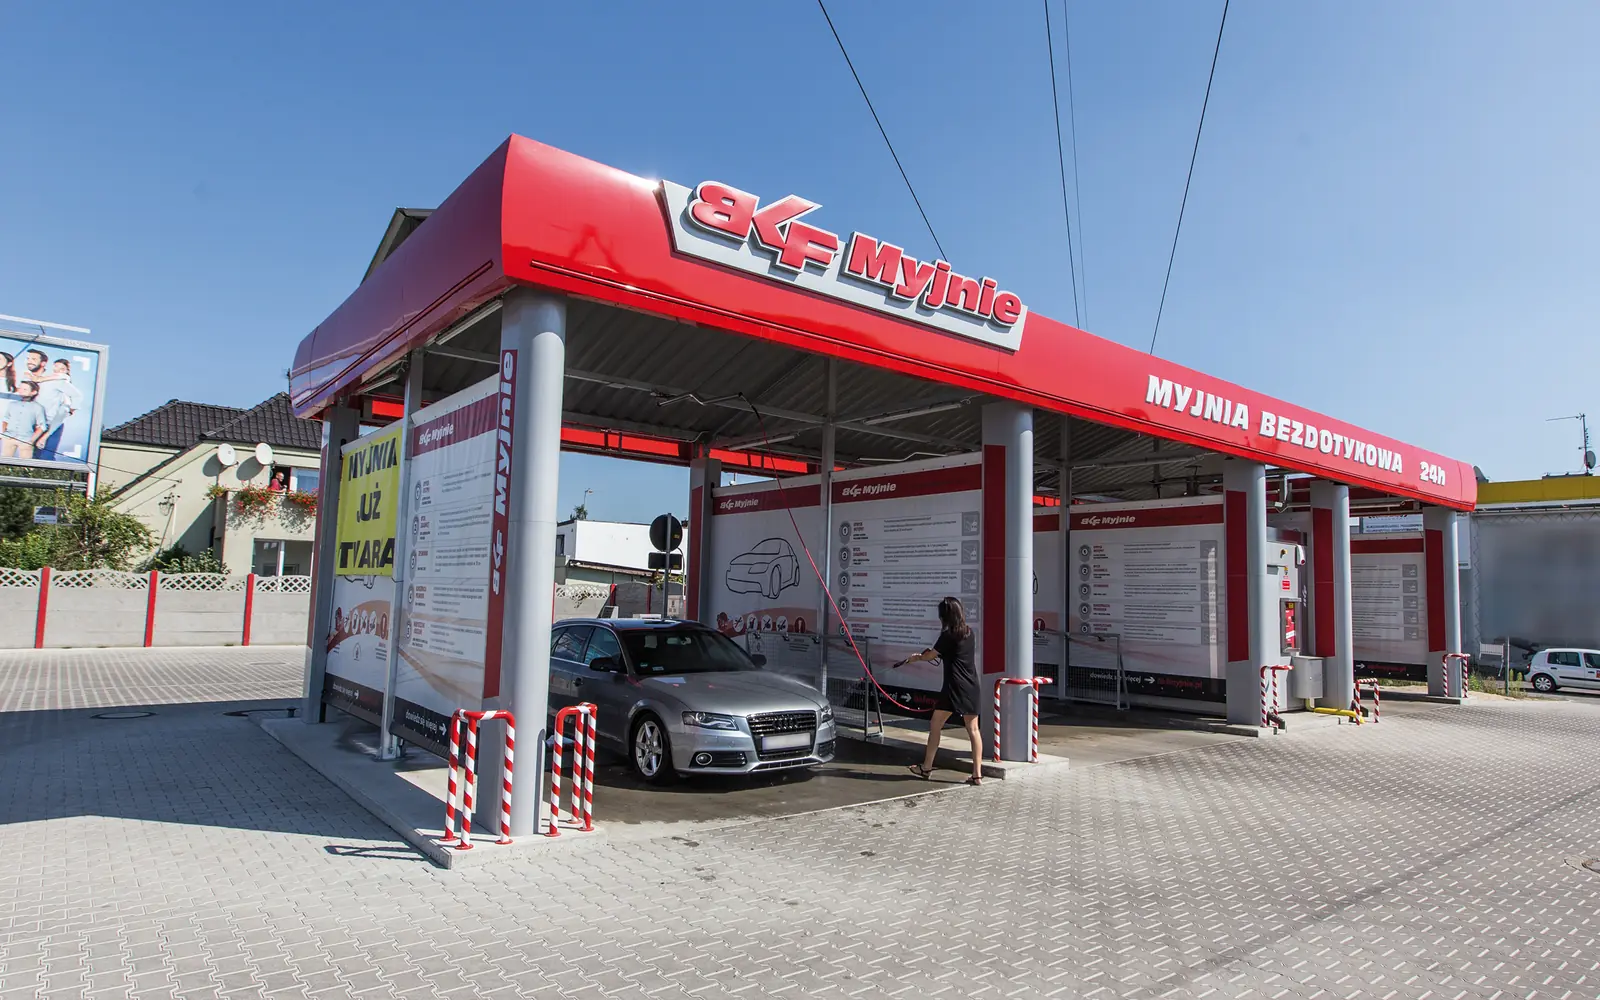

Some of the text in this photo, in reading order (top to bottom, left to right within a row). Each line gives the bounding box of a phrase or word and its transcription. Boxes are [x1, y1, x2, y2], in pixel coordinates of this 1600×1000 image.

[687, 181, 1023, 326] BKF Myjnie
[431, 423, 454, 441] Myjnie
[495, 352, 514, 517] Myjnie
[1146, 375, 1447, 486] MYJNIA BEZDOTYKOWA 24h
[356, 482, 381, 522] JUŻ
[734, 498, 759, 509] Myjnie
[842, 482, 897, 497] BKF Myjnie
[1101, 515, 1136, 525] Myjnie
